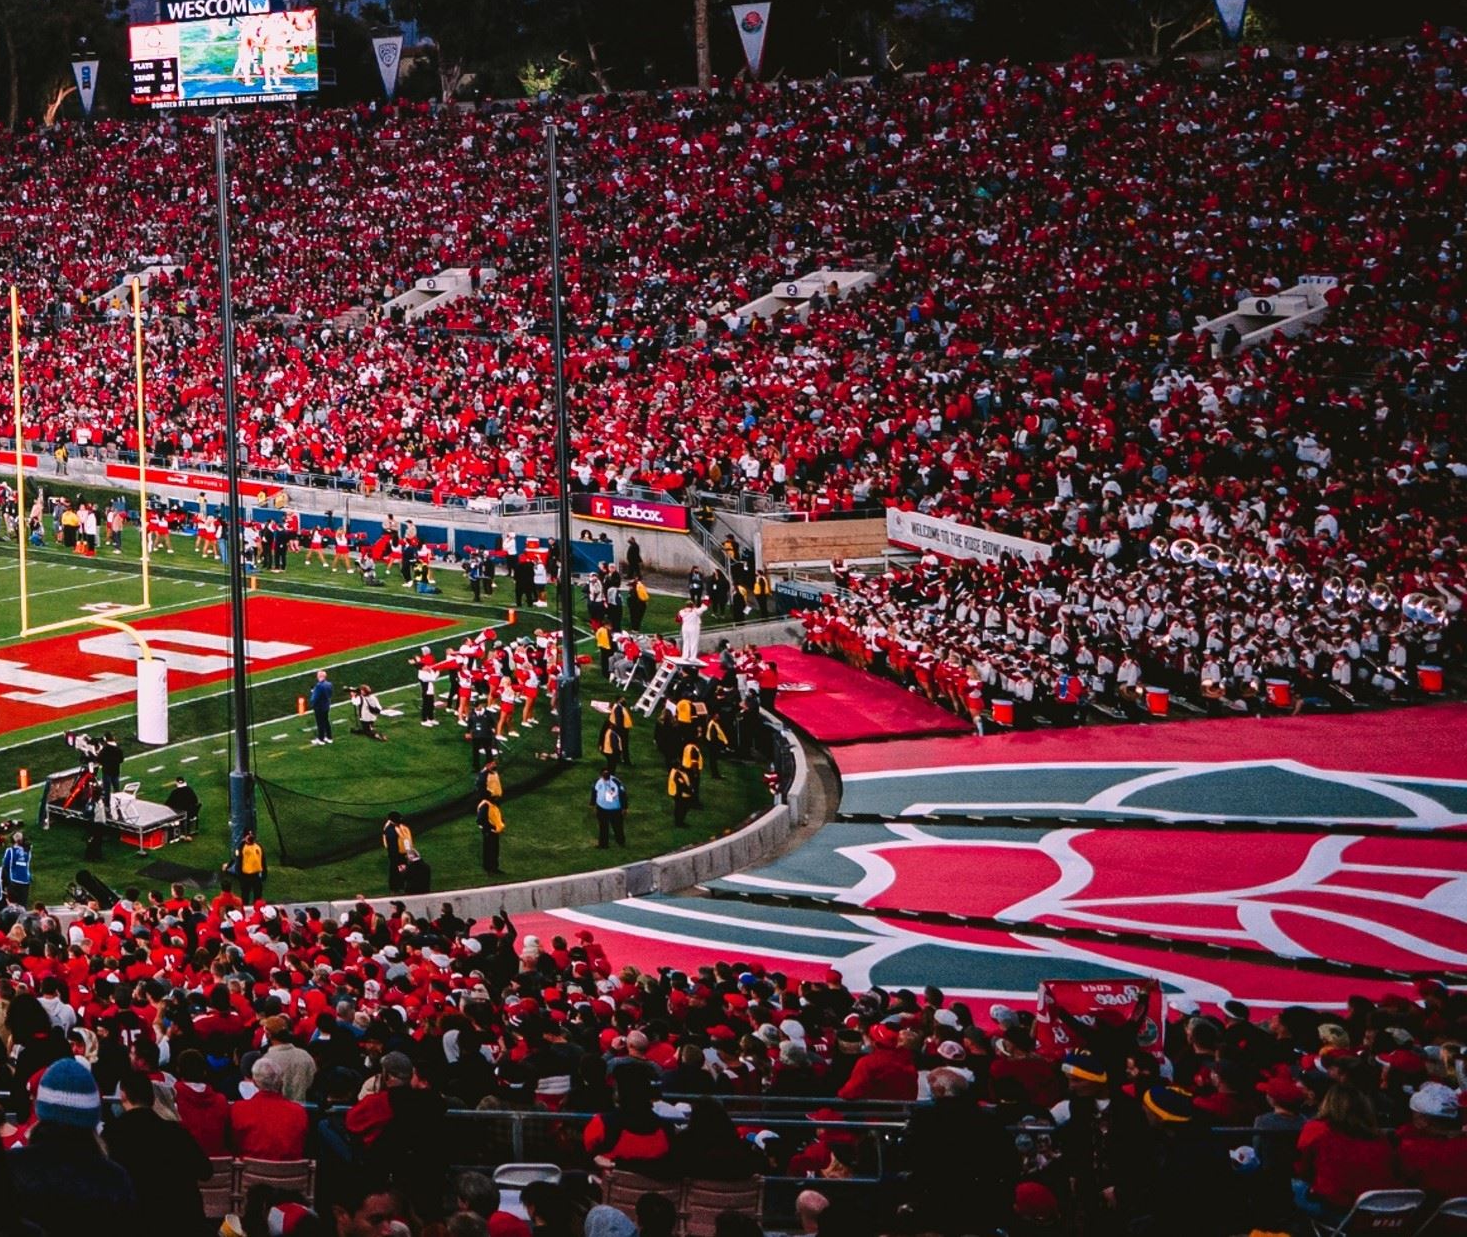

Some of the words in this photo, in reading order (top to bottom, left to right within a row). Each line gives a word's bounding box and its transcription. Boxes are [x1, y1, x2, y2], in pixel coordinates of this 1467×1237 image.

[911, 522, 940, 542] WELCOME
[941, 530, 950, 544] TO
[950, 532, 962, 549] THE
[964, 536, 981, 553] ROSE
[982, 540, 1002, 558] BOWL
